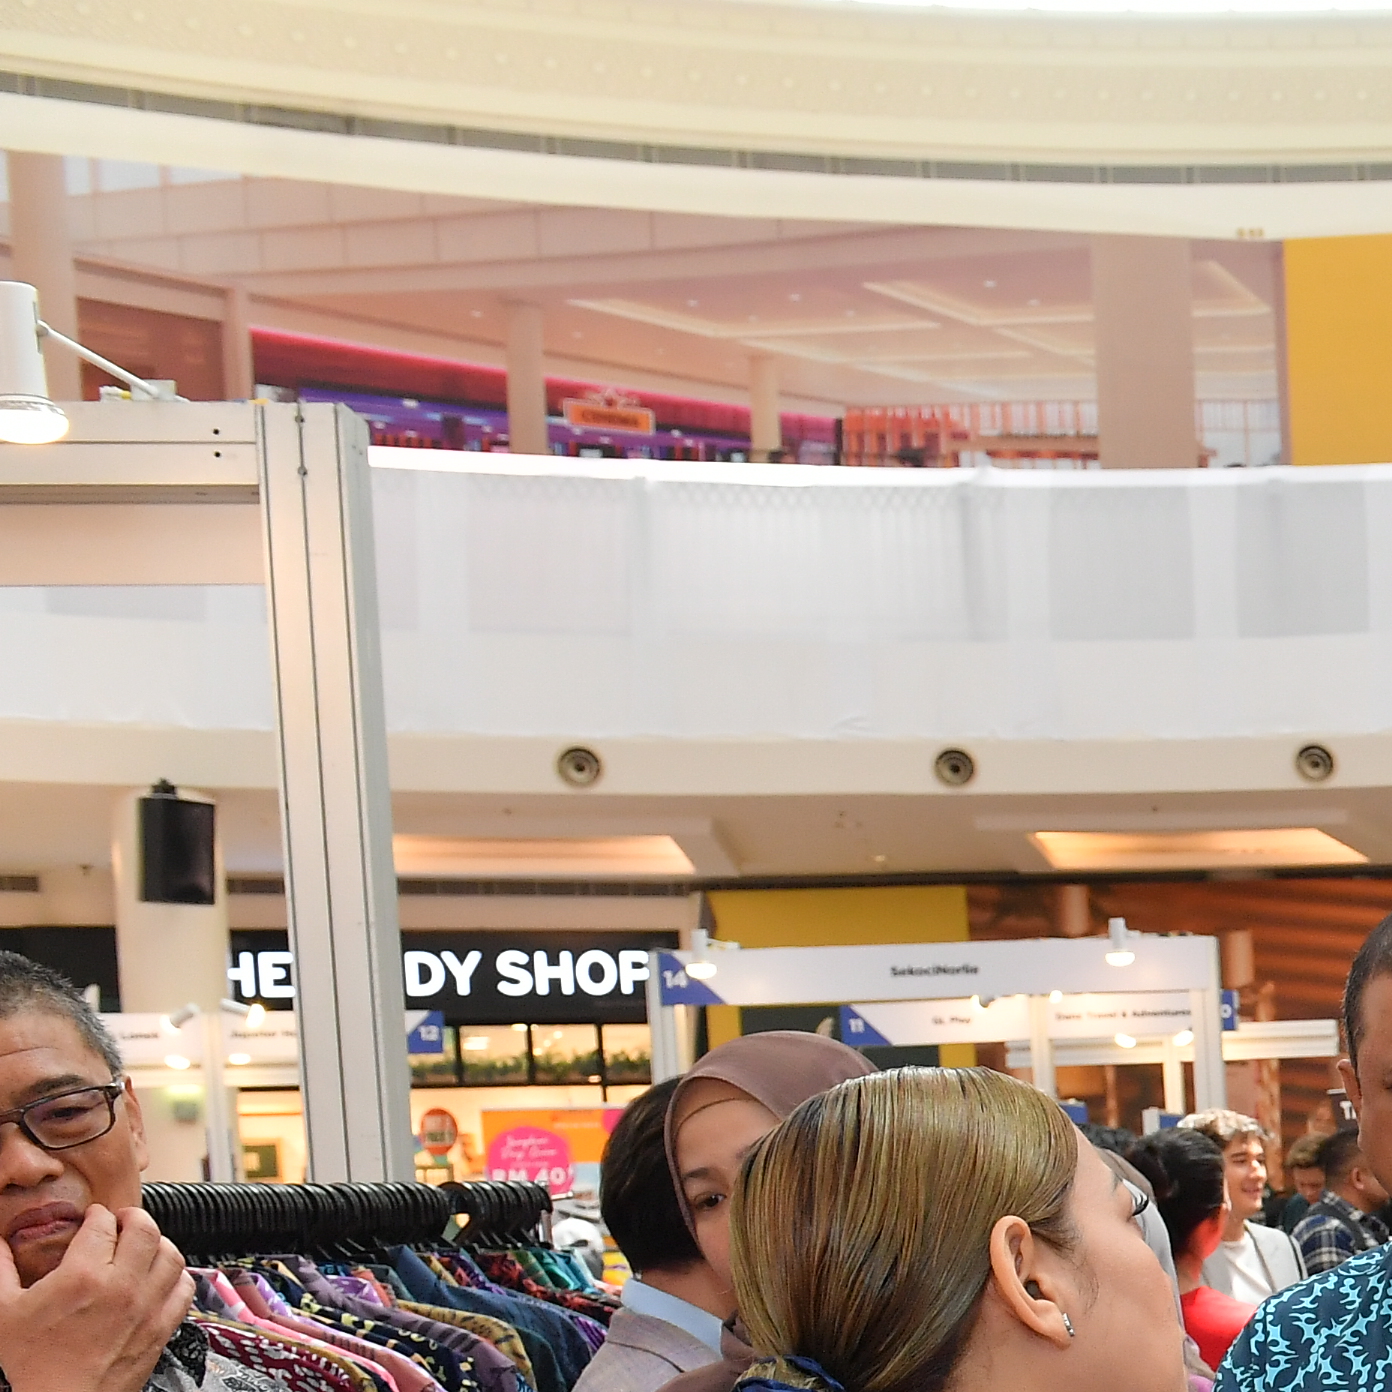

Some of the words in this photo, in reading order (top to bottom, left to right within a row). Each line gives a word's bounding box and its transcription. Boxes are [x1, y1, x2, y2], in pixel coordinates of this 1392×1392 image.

[496, 950, 650, 996] SHOP
[663, 970, 689, 989] 14
[418, 1025, 440, 1040] 12
[849, 1018, 865, 1033] 11
